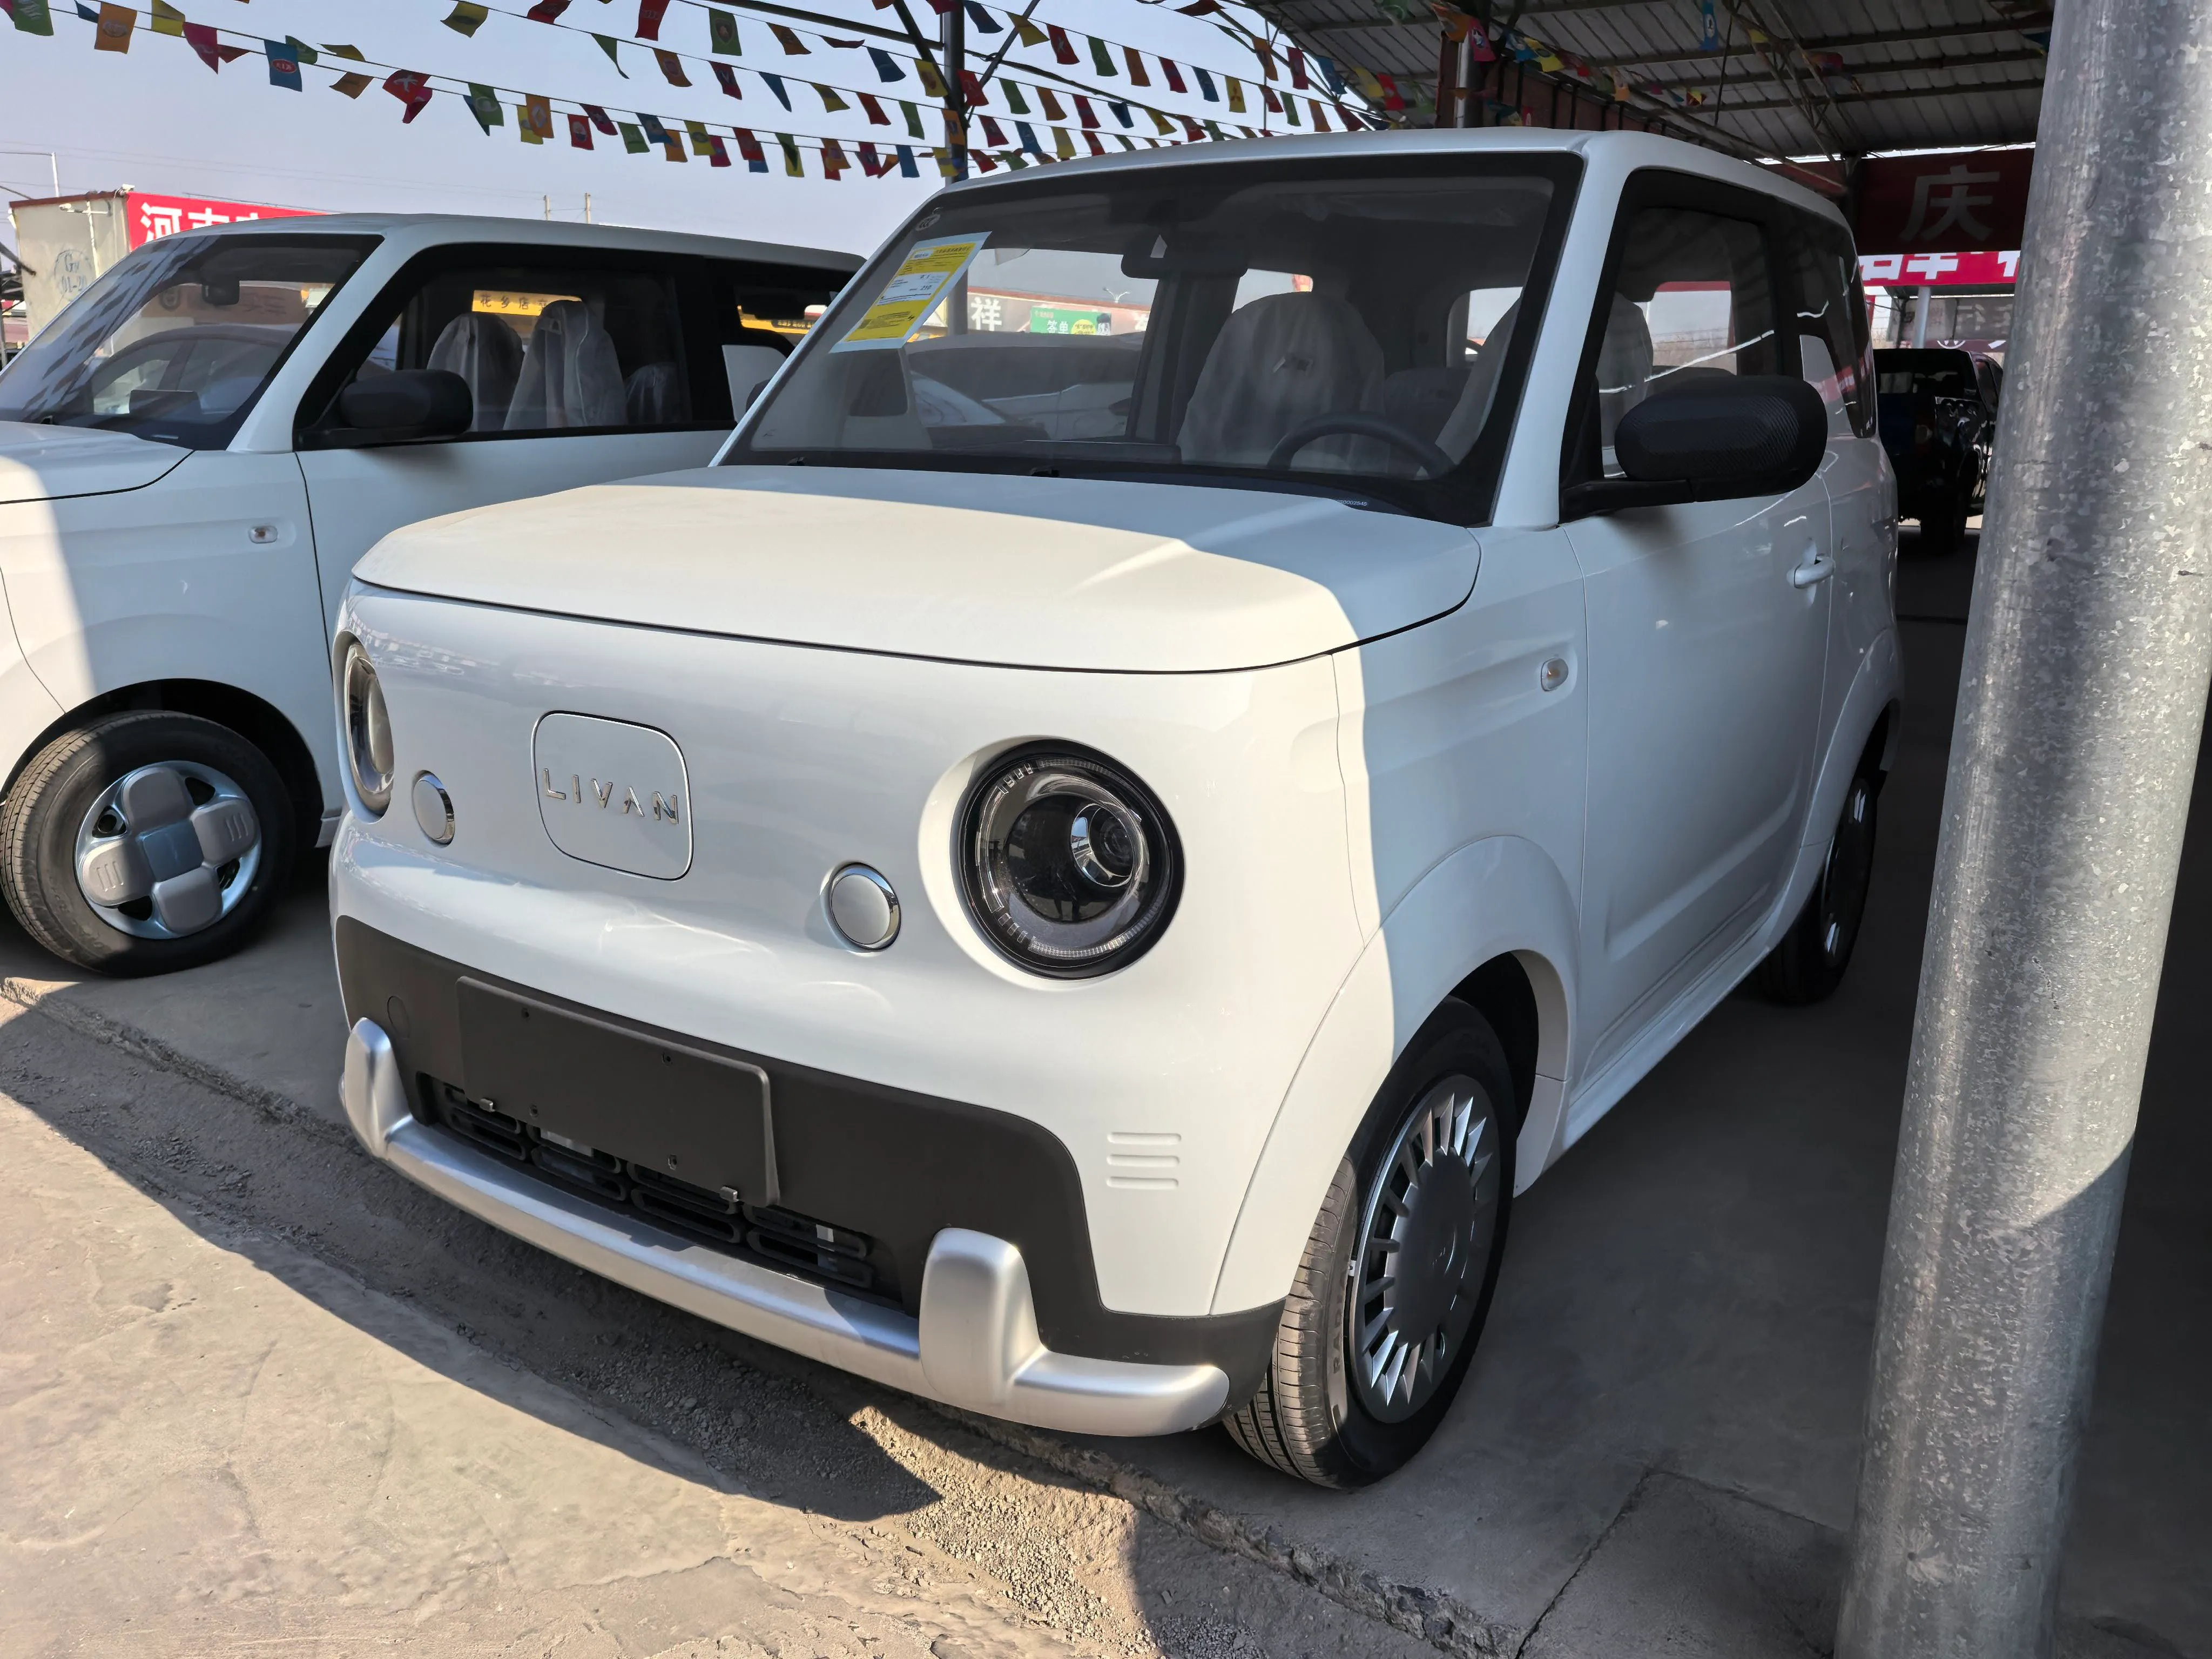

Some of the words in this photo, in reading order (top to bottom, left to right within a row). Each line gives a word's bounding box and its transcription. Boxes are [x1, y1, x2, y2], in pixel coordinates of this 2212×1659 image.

[1899, 164, 2000, 242] 庆
[970, 296, 1003, 331] 祥
[543, 767, 679, 825] LIVAN
